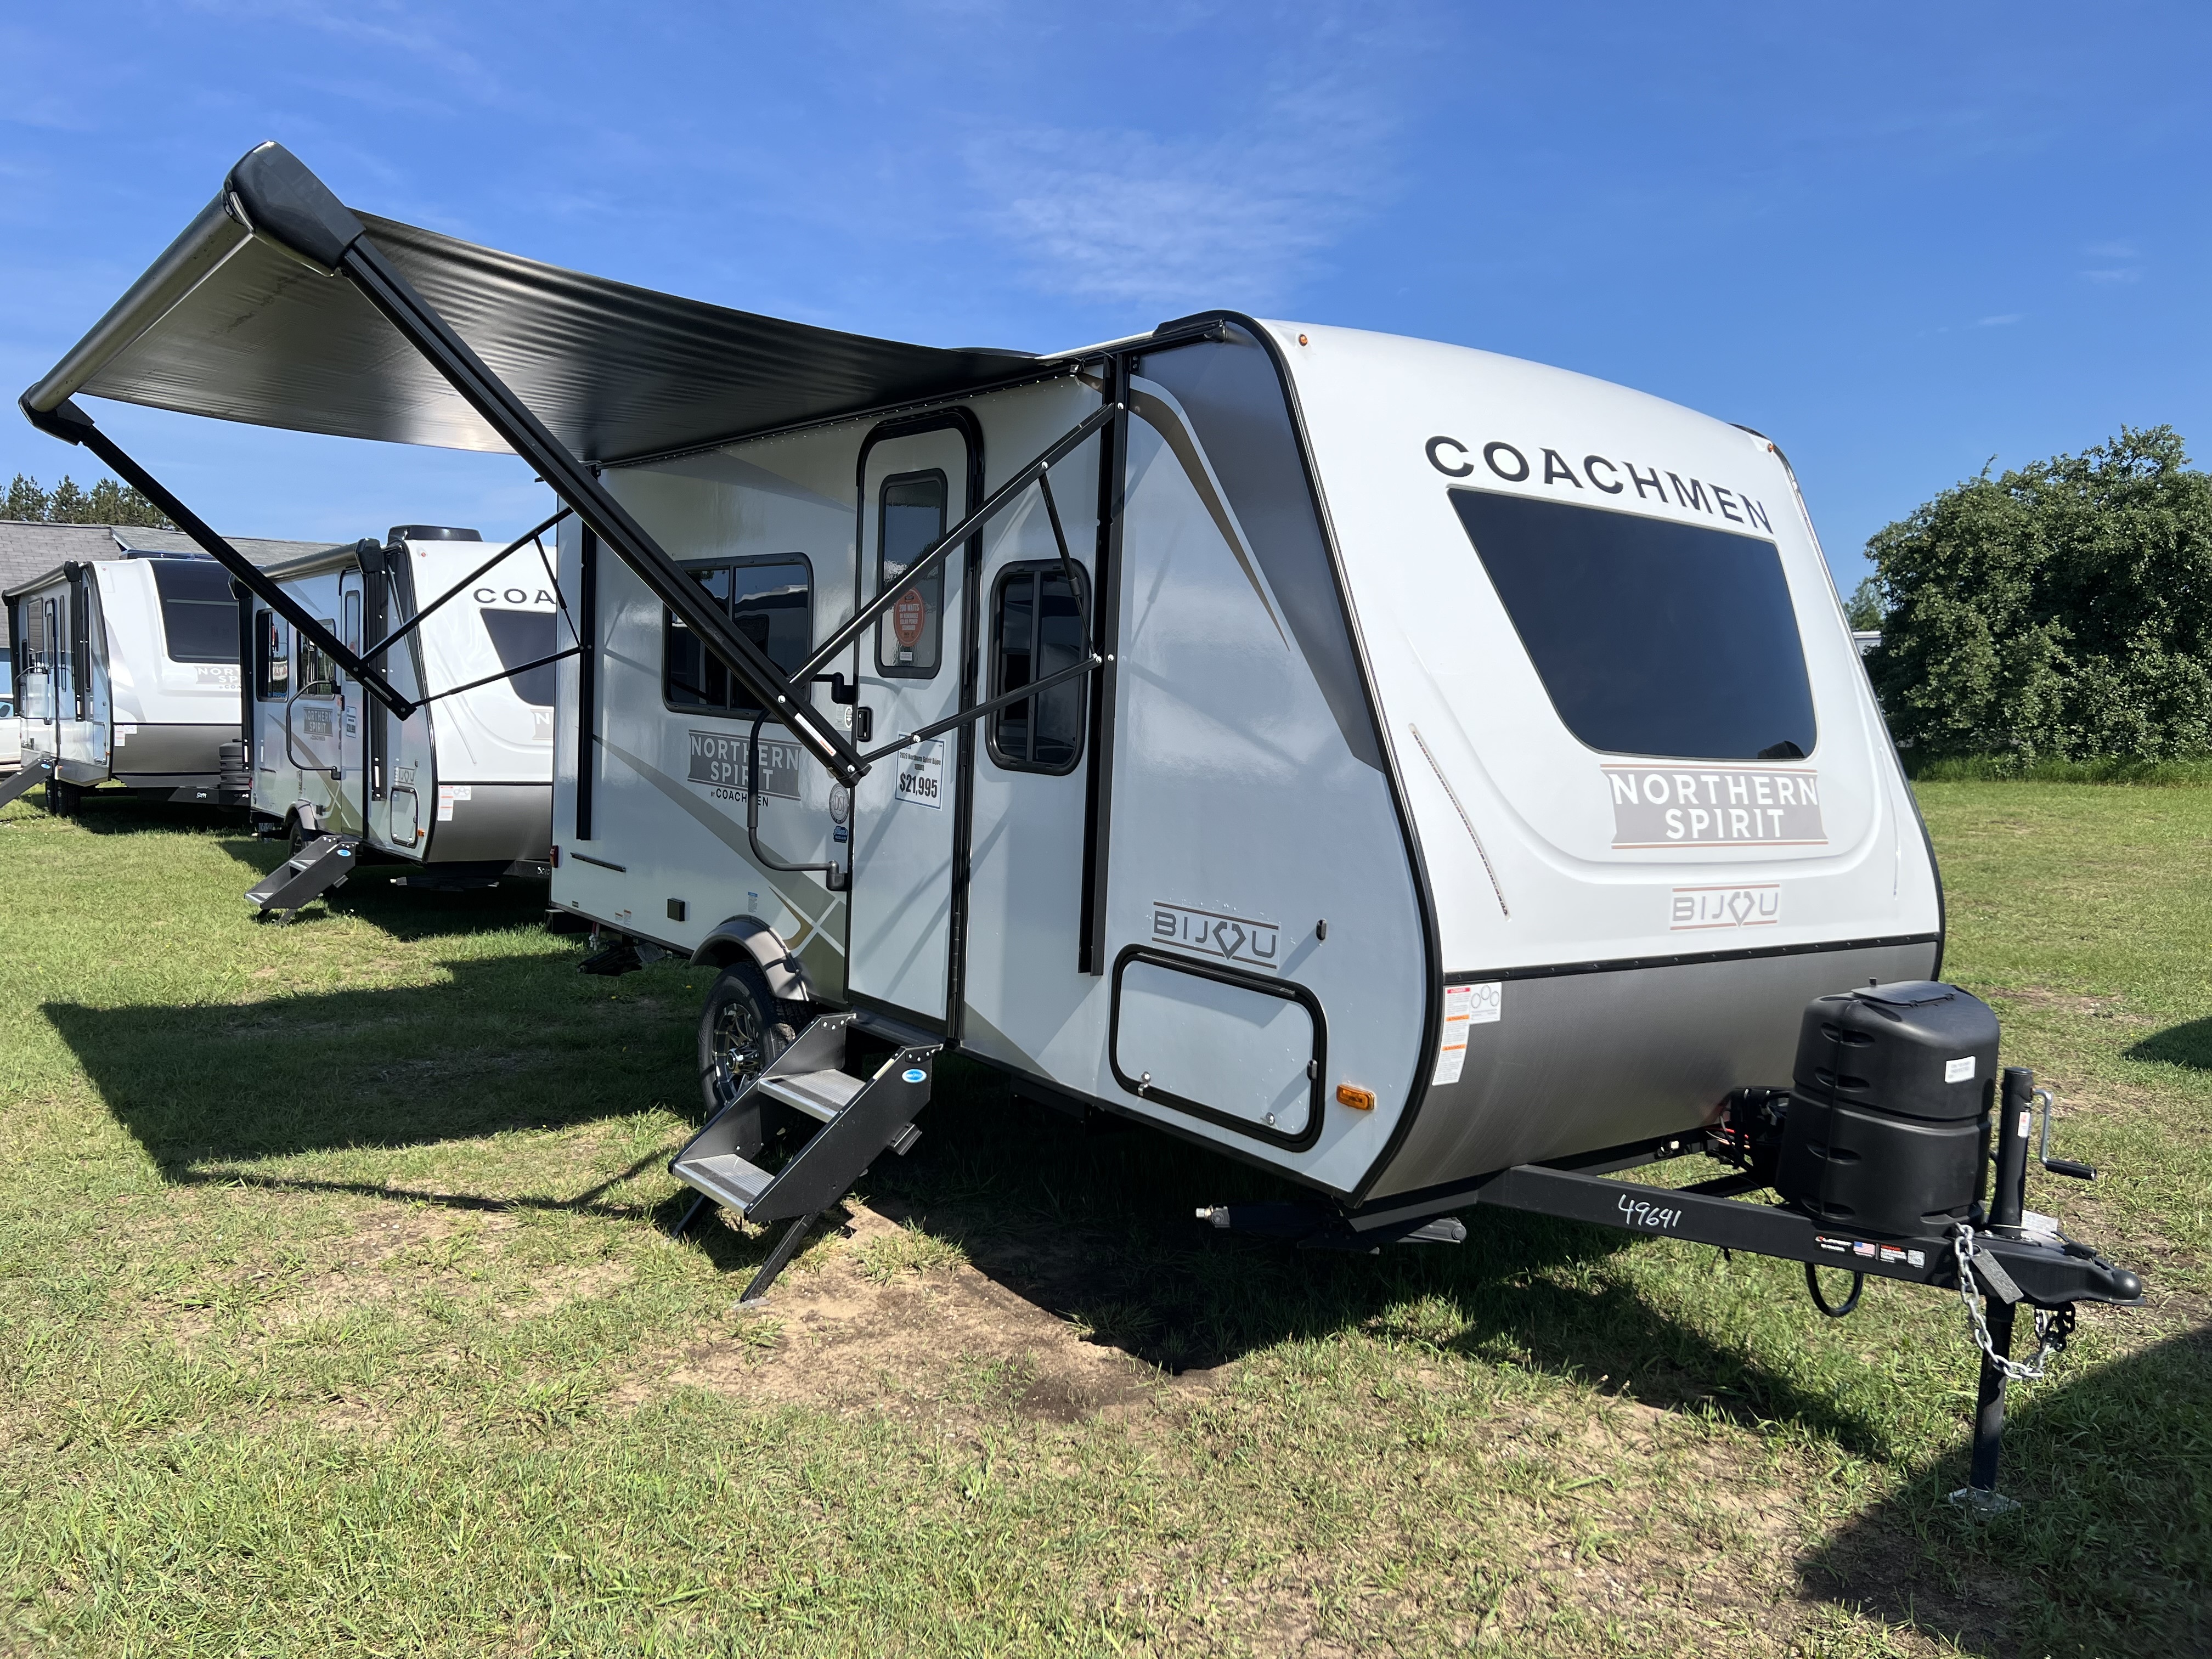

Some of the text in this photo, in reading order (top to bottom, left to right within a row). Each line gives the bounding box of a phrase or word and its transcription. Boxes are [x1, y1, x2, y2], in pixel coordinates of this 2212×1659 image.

[1425, 435, 1774, 535] COACHMEN
[304, 710, 332, 723] NORTHERN
[309, 722, 326, 733] SPIRIT
[394, 769, 415, 783] IJOU
[710, 761, 774, 789] SPIRT
[900, 772, 938, 798] $21,995
[716, 788, 769, 807] COACHEN
[1608, 772, 1819, 807] NORTHERN
[1666, 808, 1785, 839] SPIRIT
[1672, 890, 1779, 927] BIJOU
[1153, 912, 1276, 960] BIJOU
